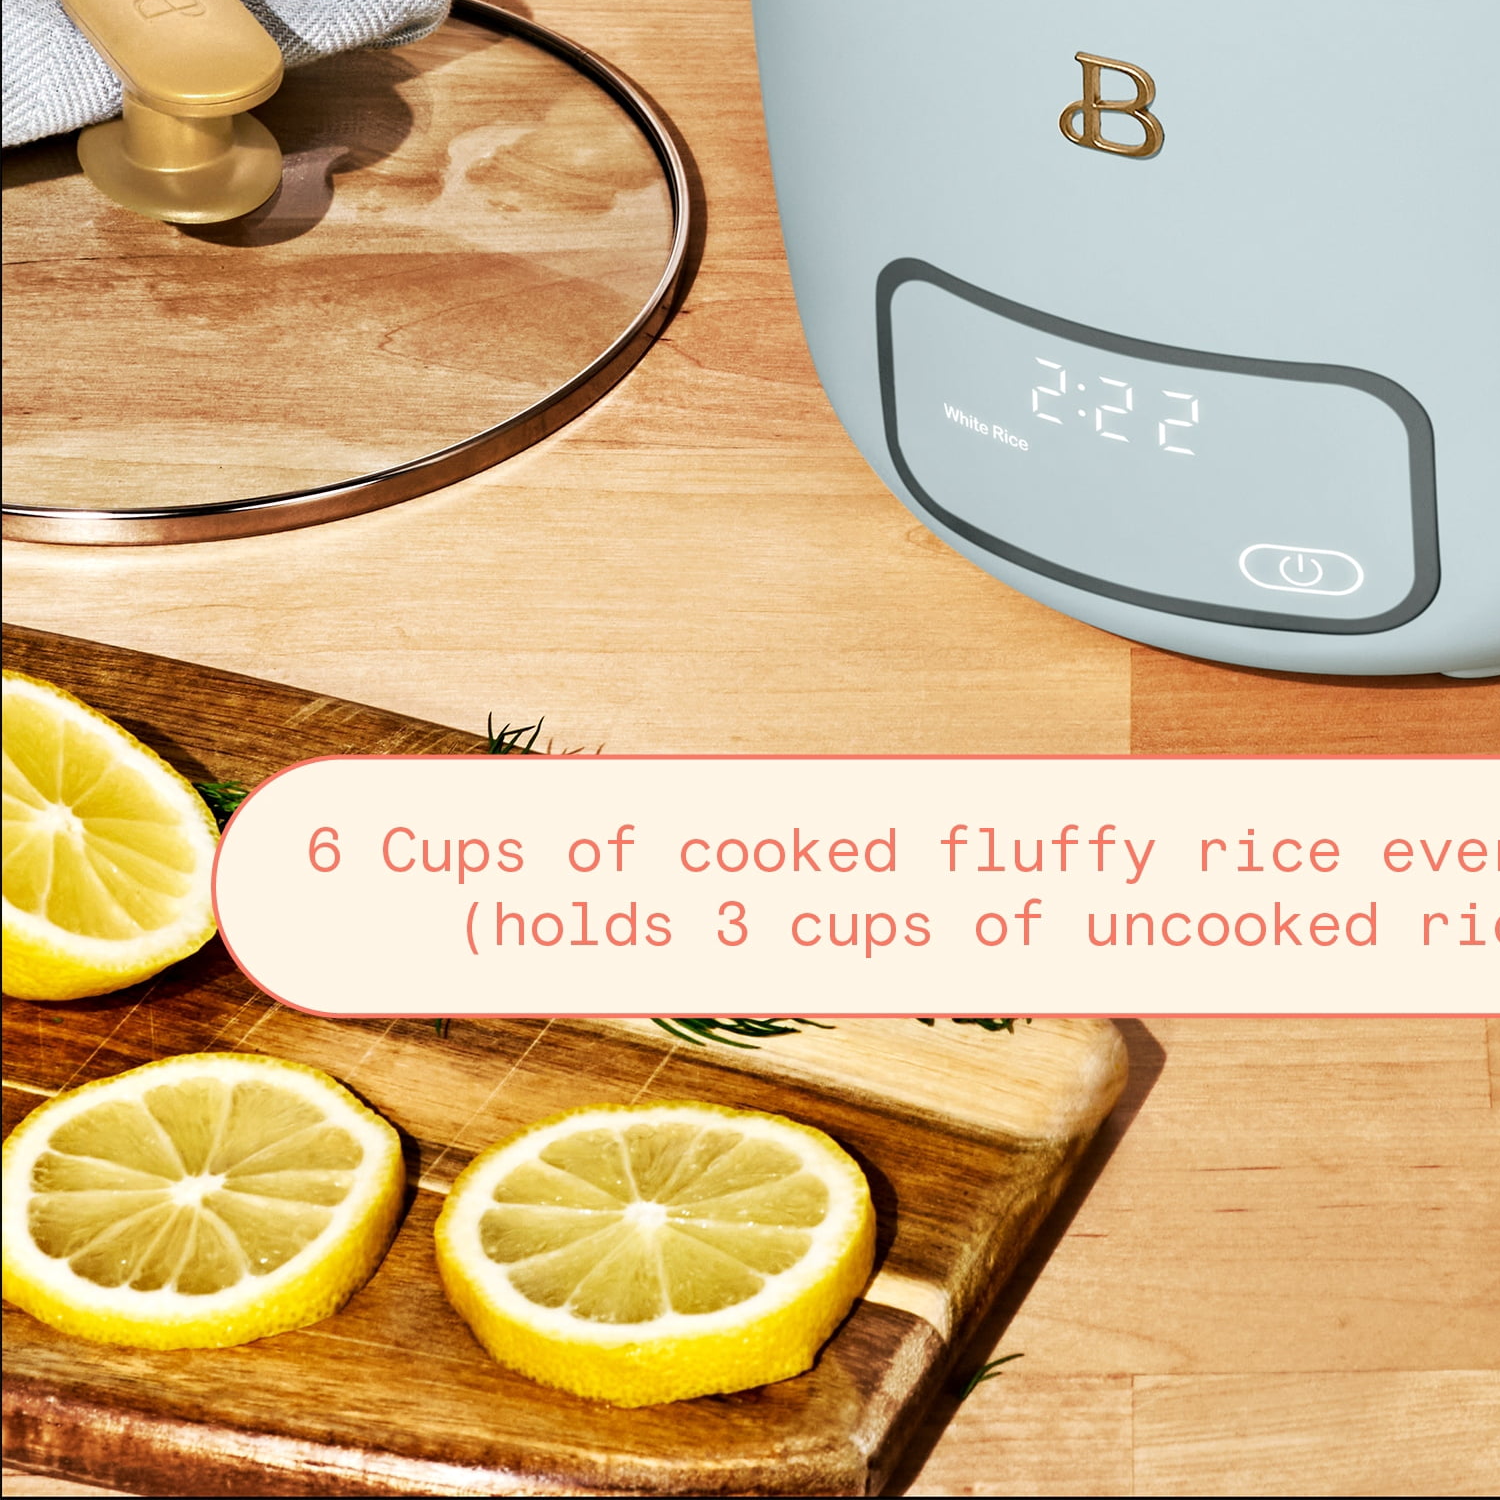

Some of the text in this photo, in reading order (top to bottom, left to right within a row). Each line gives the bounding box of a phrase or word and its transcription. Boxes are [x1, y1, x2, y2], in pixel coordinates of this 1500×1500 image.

[1059, 51, 1165, 160] B
[943, 402, 1029, 452] White Rice
[1032, 356, 1199, 456] 2:22
